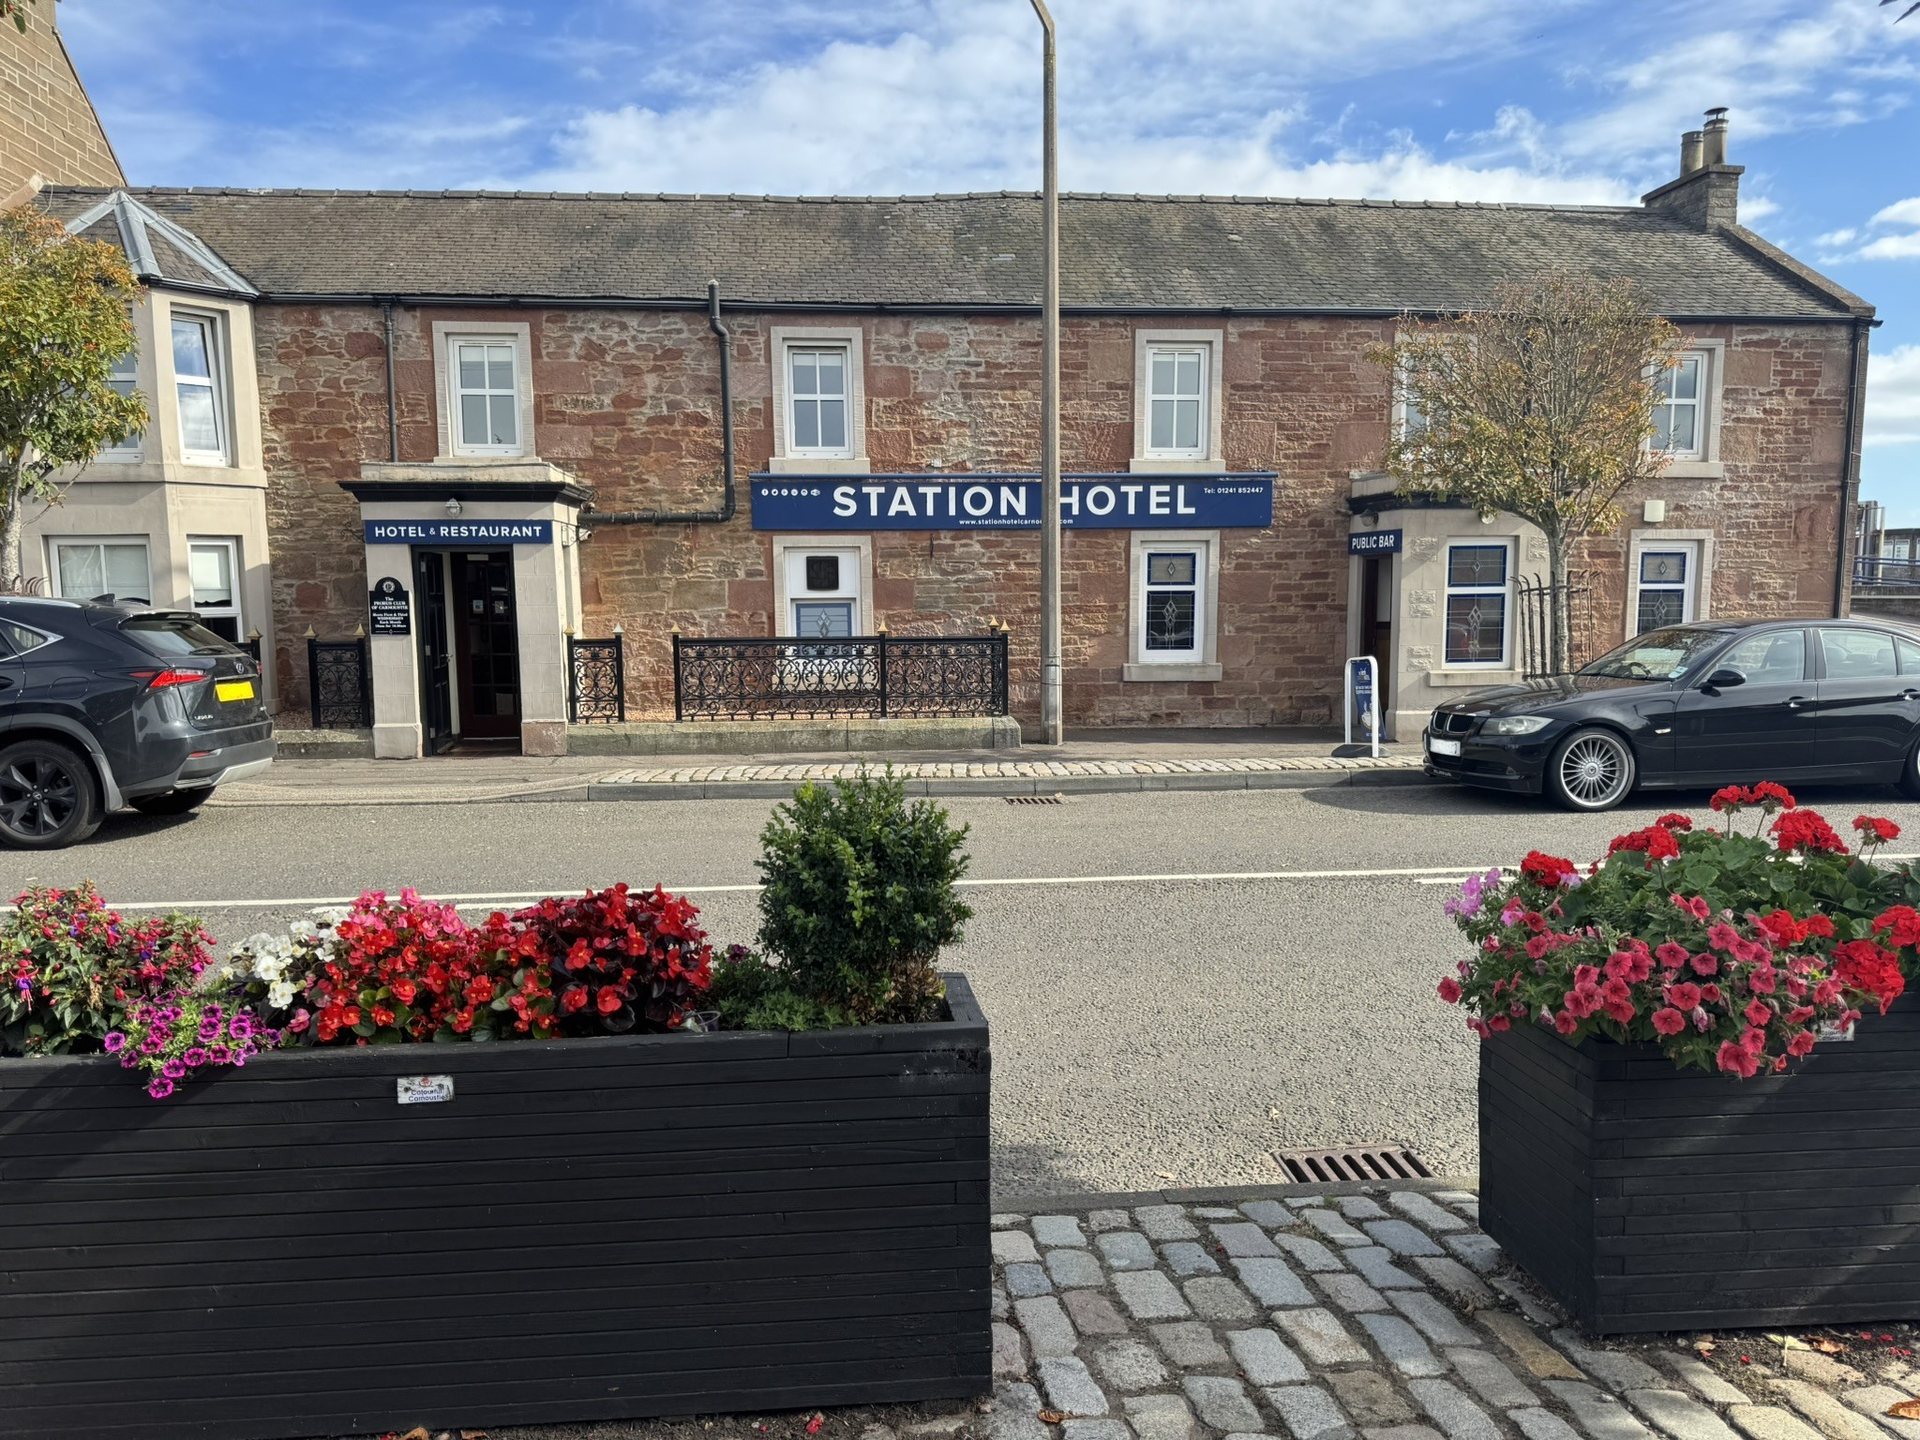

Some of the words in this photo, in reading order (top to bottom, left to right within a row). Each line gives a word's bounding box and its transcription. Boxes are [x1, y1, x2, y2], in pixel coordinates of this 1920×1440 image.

[833, 485, 1027, 517] STATION
[1060, 485, 1196, 516] HOTEL
[374, 526, 426, 537] HOTEL
[429, 527, 436, 536] &
[440, 526, 542, 537] RESTAURANT
[1352, 536, 1377, 550] PUBLIC
[1378, 535, 1394, 548] BAR
